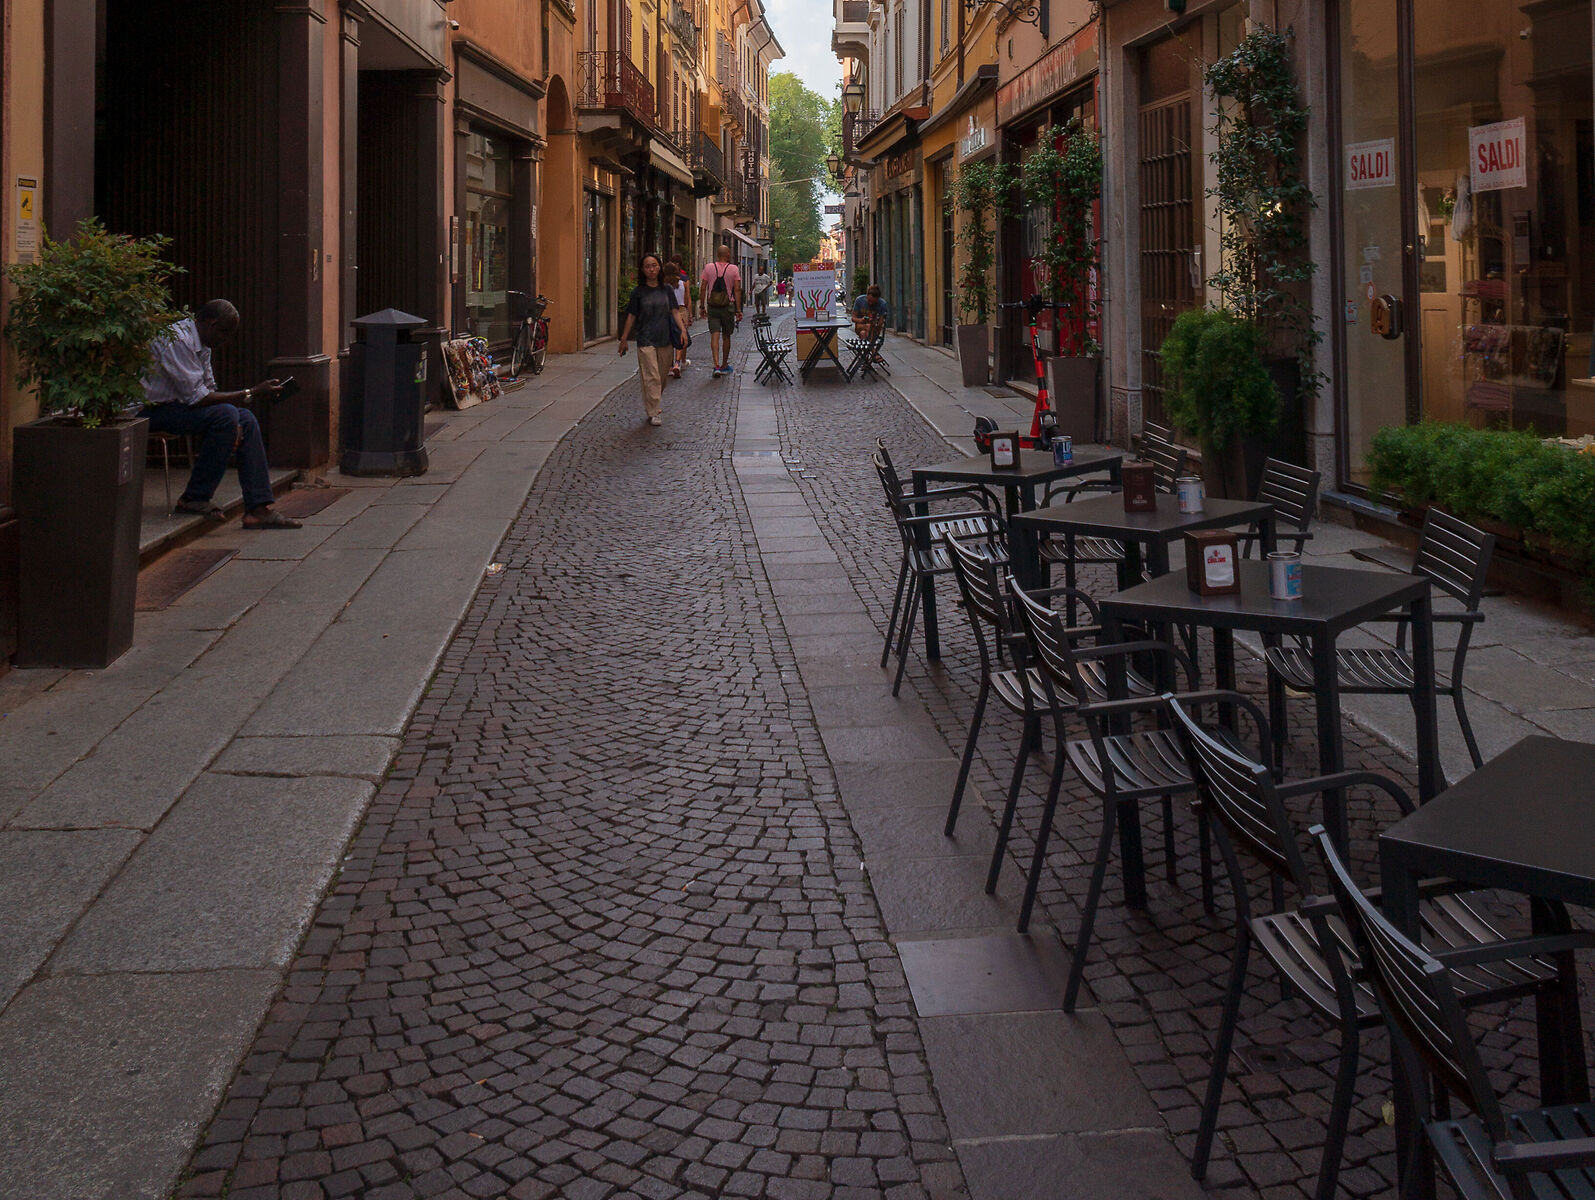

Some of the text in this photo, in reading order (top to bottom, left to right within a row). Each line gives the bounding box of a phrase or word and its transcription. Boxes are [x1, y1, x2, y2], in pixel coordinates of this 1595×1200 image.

[1054, 38, 1076, 88] STORE
[747, 151, 755, 179] HOTEL
[1351, 150, 1389, 181] SALDI
[1478, 137, 1520, 174] SALDI
